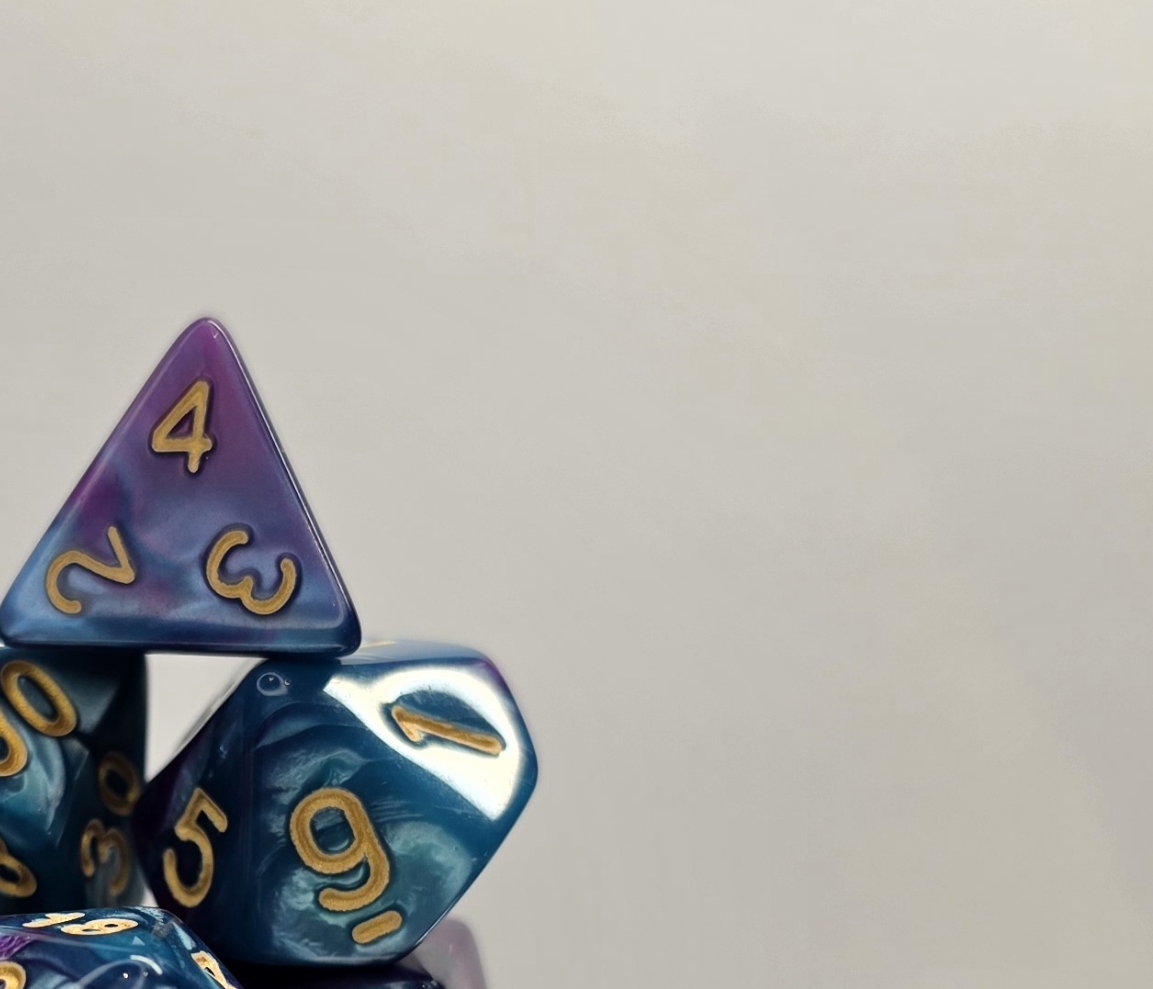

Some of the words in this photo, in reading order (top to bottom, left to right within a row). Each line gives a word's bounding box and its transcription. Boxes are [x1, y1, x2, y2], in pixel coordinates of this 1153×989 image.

[151, 380, 214, 474] 4
[46, 525, 136, 615] 2
[205, 529, 300, 616] 3
[391, 705, 506, 757] 1
[80, 752, 140, 897] 30
[162, 787, 229, 908] 5
[22, 912, 139, 935] 18
